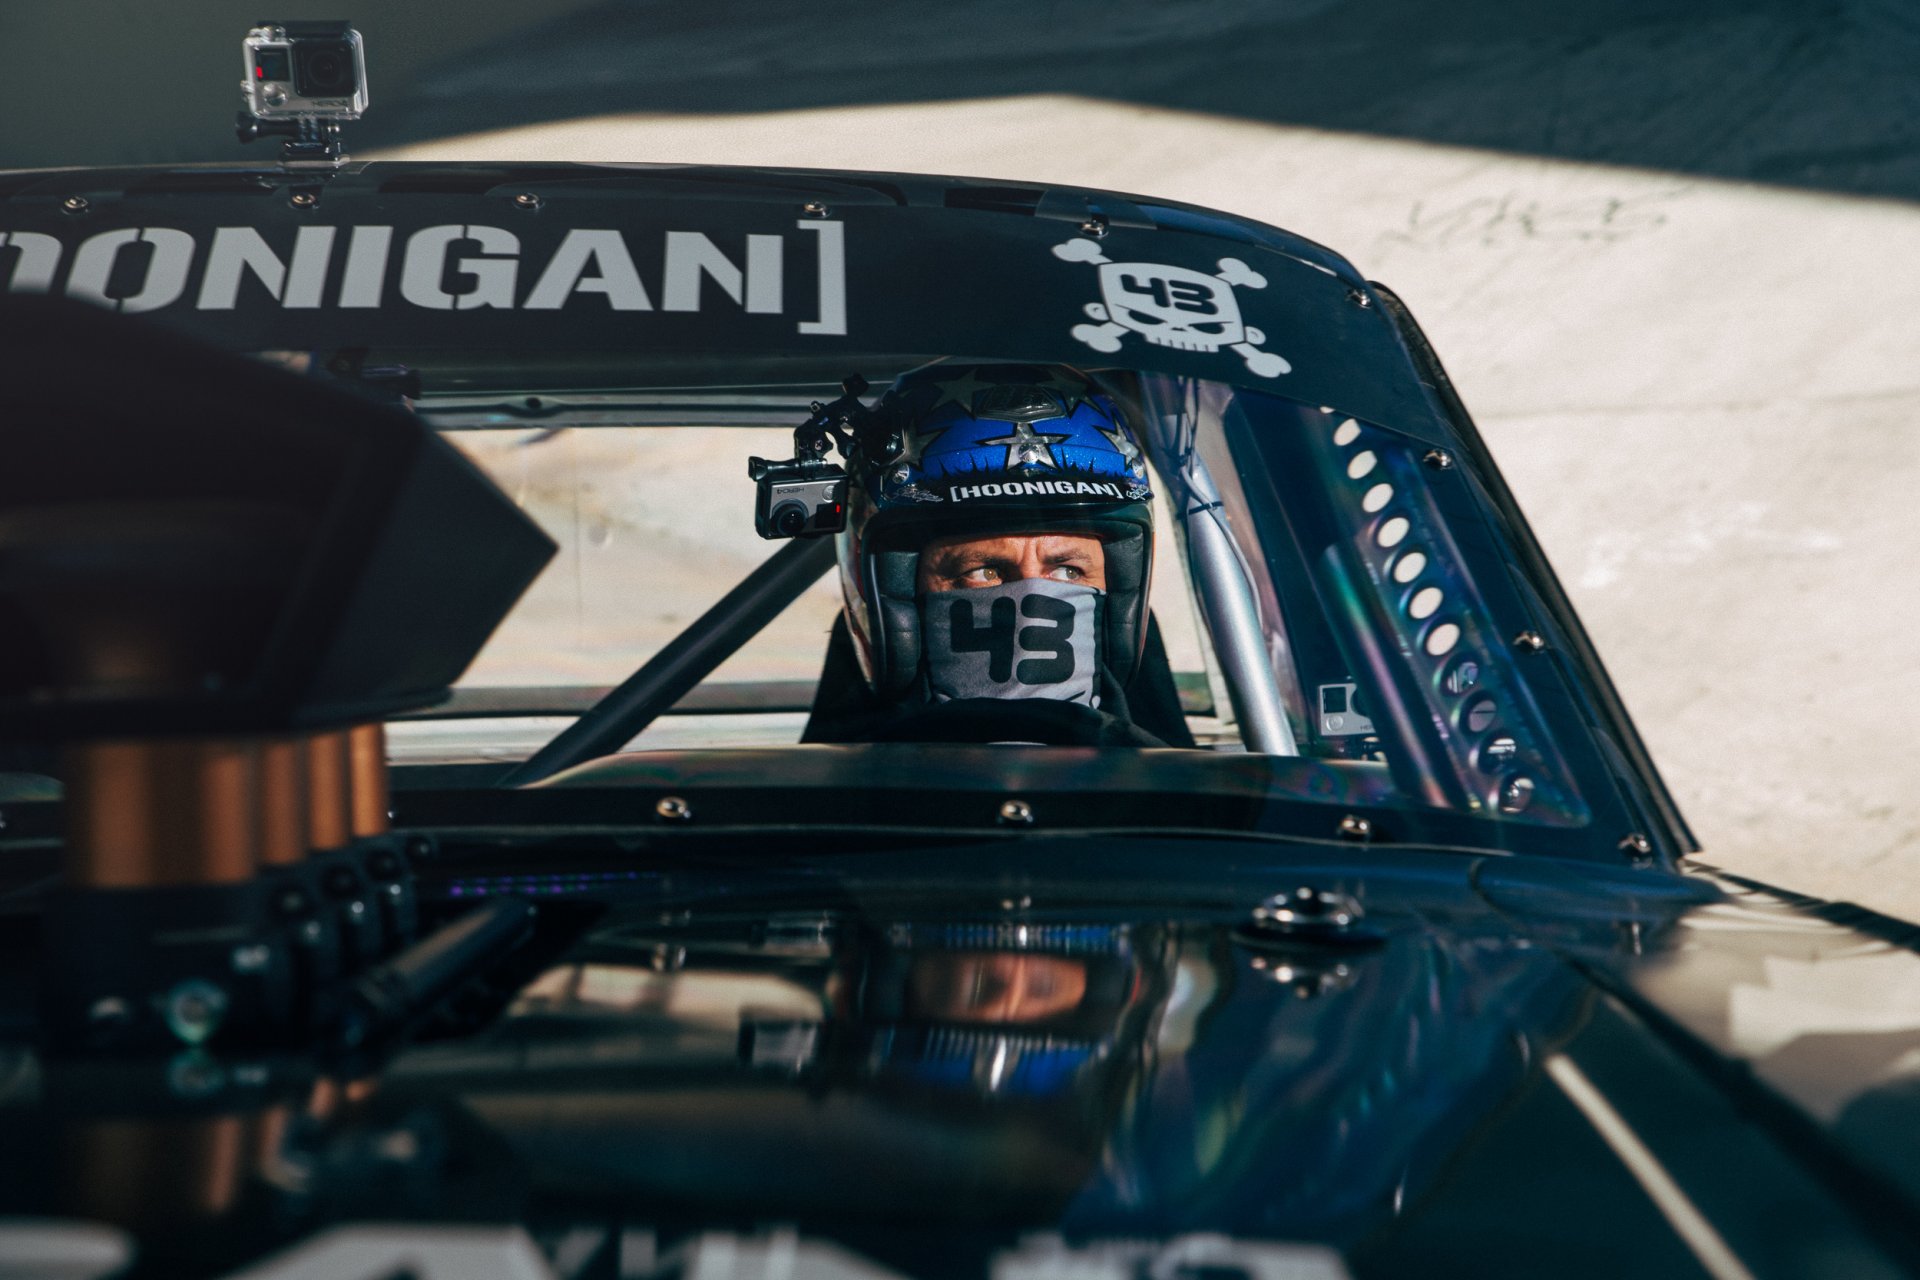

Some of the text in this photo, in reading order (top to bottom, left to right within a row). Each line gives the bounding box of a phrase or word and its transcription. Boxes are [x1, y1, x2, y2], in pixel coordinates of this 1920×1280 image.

[1120, 274, 1218, 315] 43
[950, 481, 1124, 503] [HOONIGAN]
[950, 593, 1076, 685] 43
